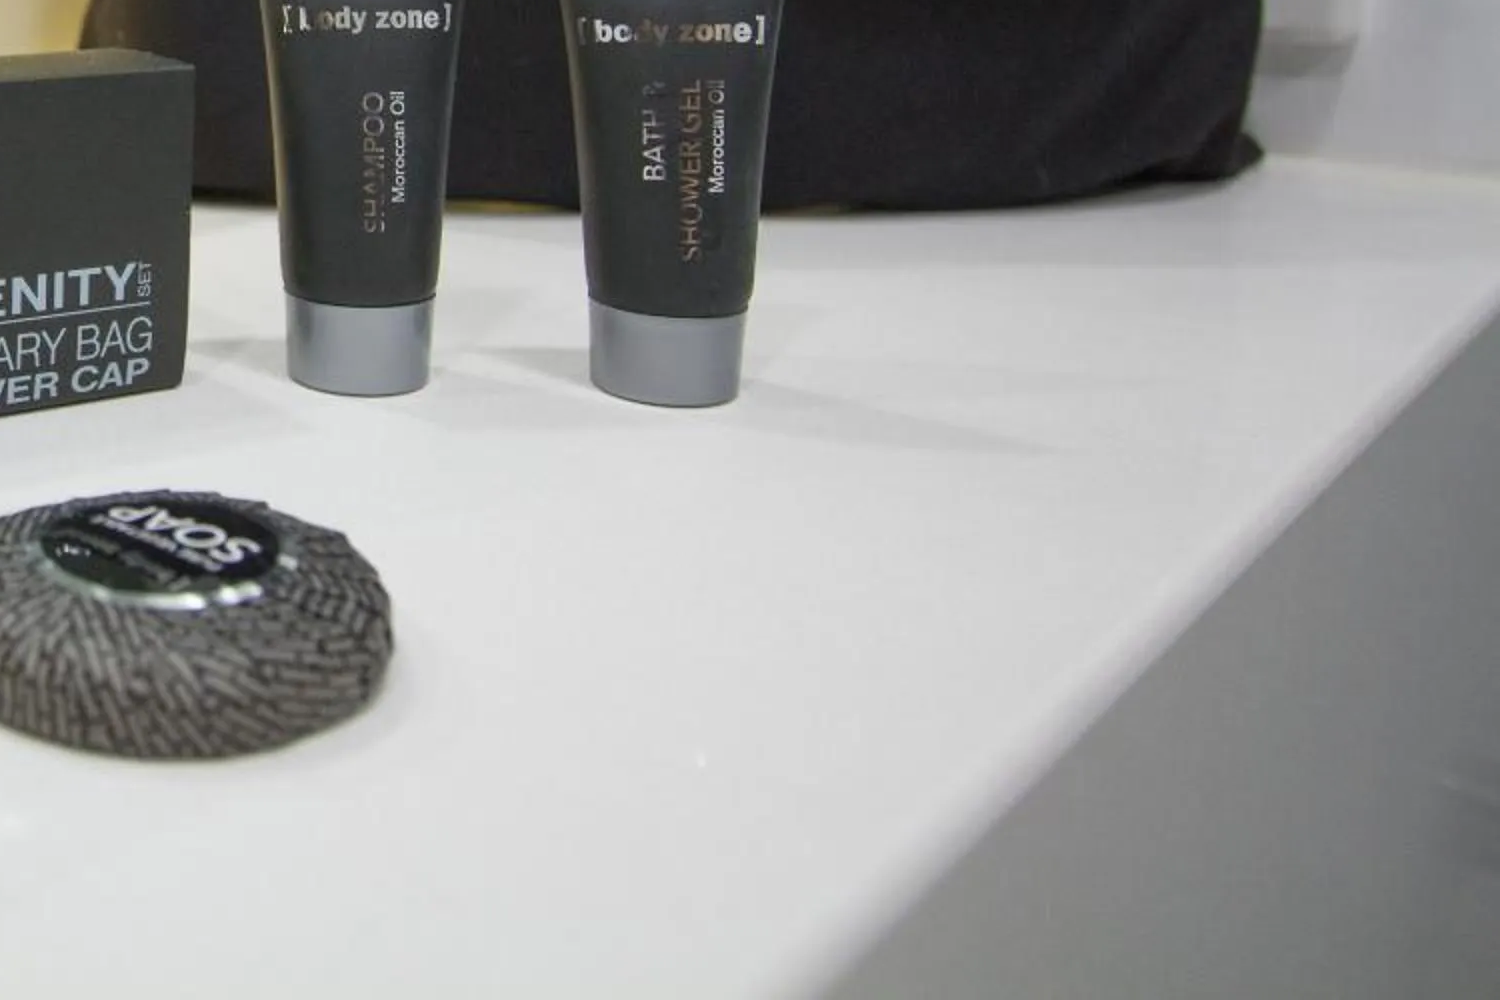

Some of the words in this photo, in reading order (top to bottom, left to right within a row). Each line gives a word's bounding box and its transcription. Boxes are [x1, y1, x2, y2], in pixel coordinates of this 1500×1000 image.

[389, 90, 406, 116] Oil
[680, 79, 704, 134] GEL
[391, 119, 406, 204] Moroccan
[707, 109, 726, 194] Moroccan
[680, 141, 704, 263] SHOWER
[137, 260, 153, 298] SET
[75, 315, 154, 362] BAG
[71, 357, 151, 394] CAP
[107, 505, 262, 565] SOAP
